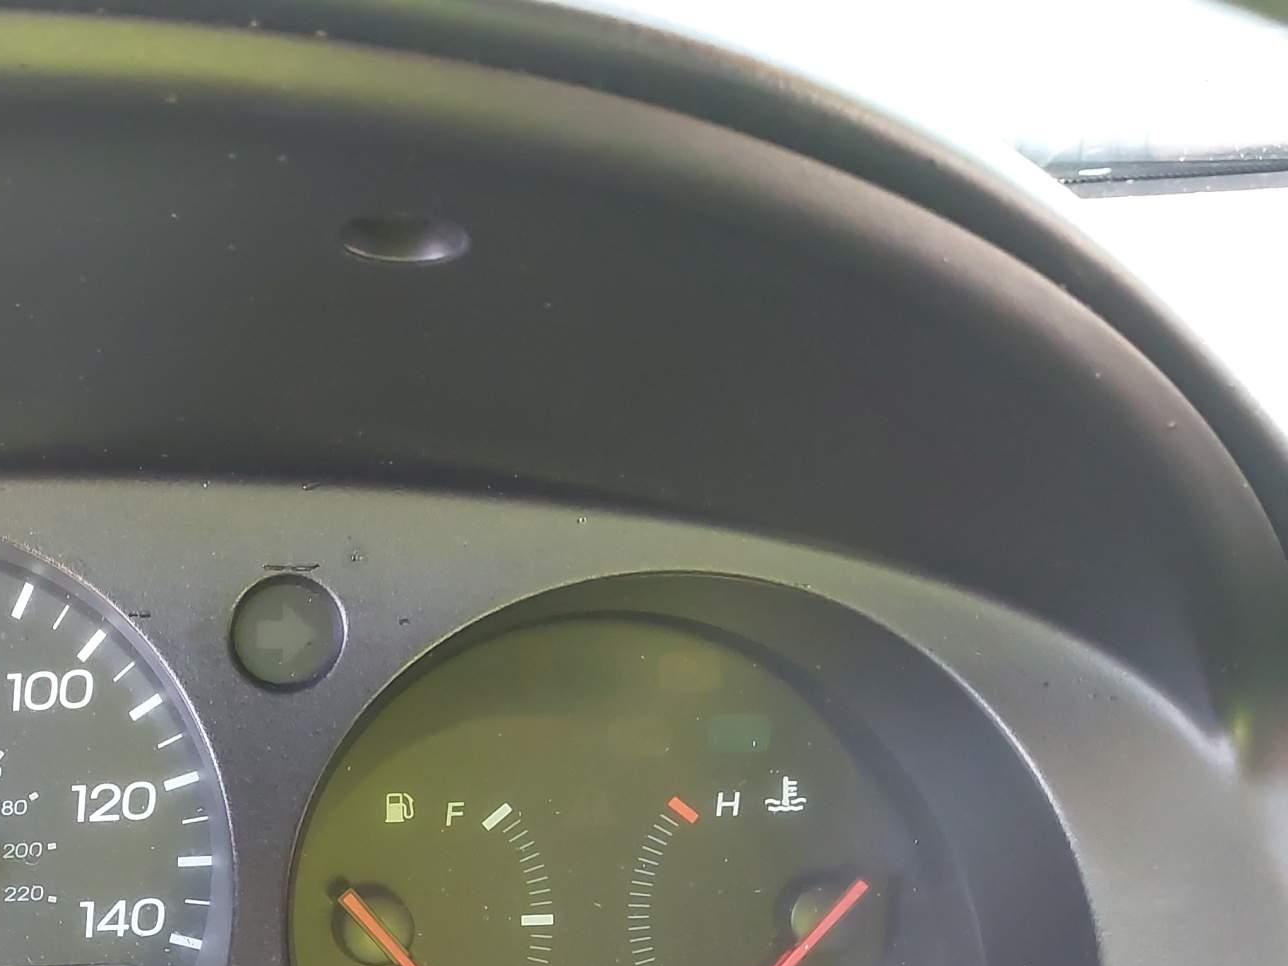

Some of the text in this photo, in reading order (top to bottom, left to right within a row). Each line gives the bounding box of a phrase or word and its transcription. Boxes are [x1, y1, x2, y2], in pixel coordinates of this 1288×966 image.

[7, 669, 93, 711] 100
[72, 782, 156, 822] 120
[446, 802, 464, 826] F
[716, 792, 740, 816] H
[3, 842, 42, 858] 200
[5, 886, 43, 901] 220
[80, 898, 164, 937] 140
